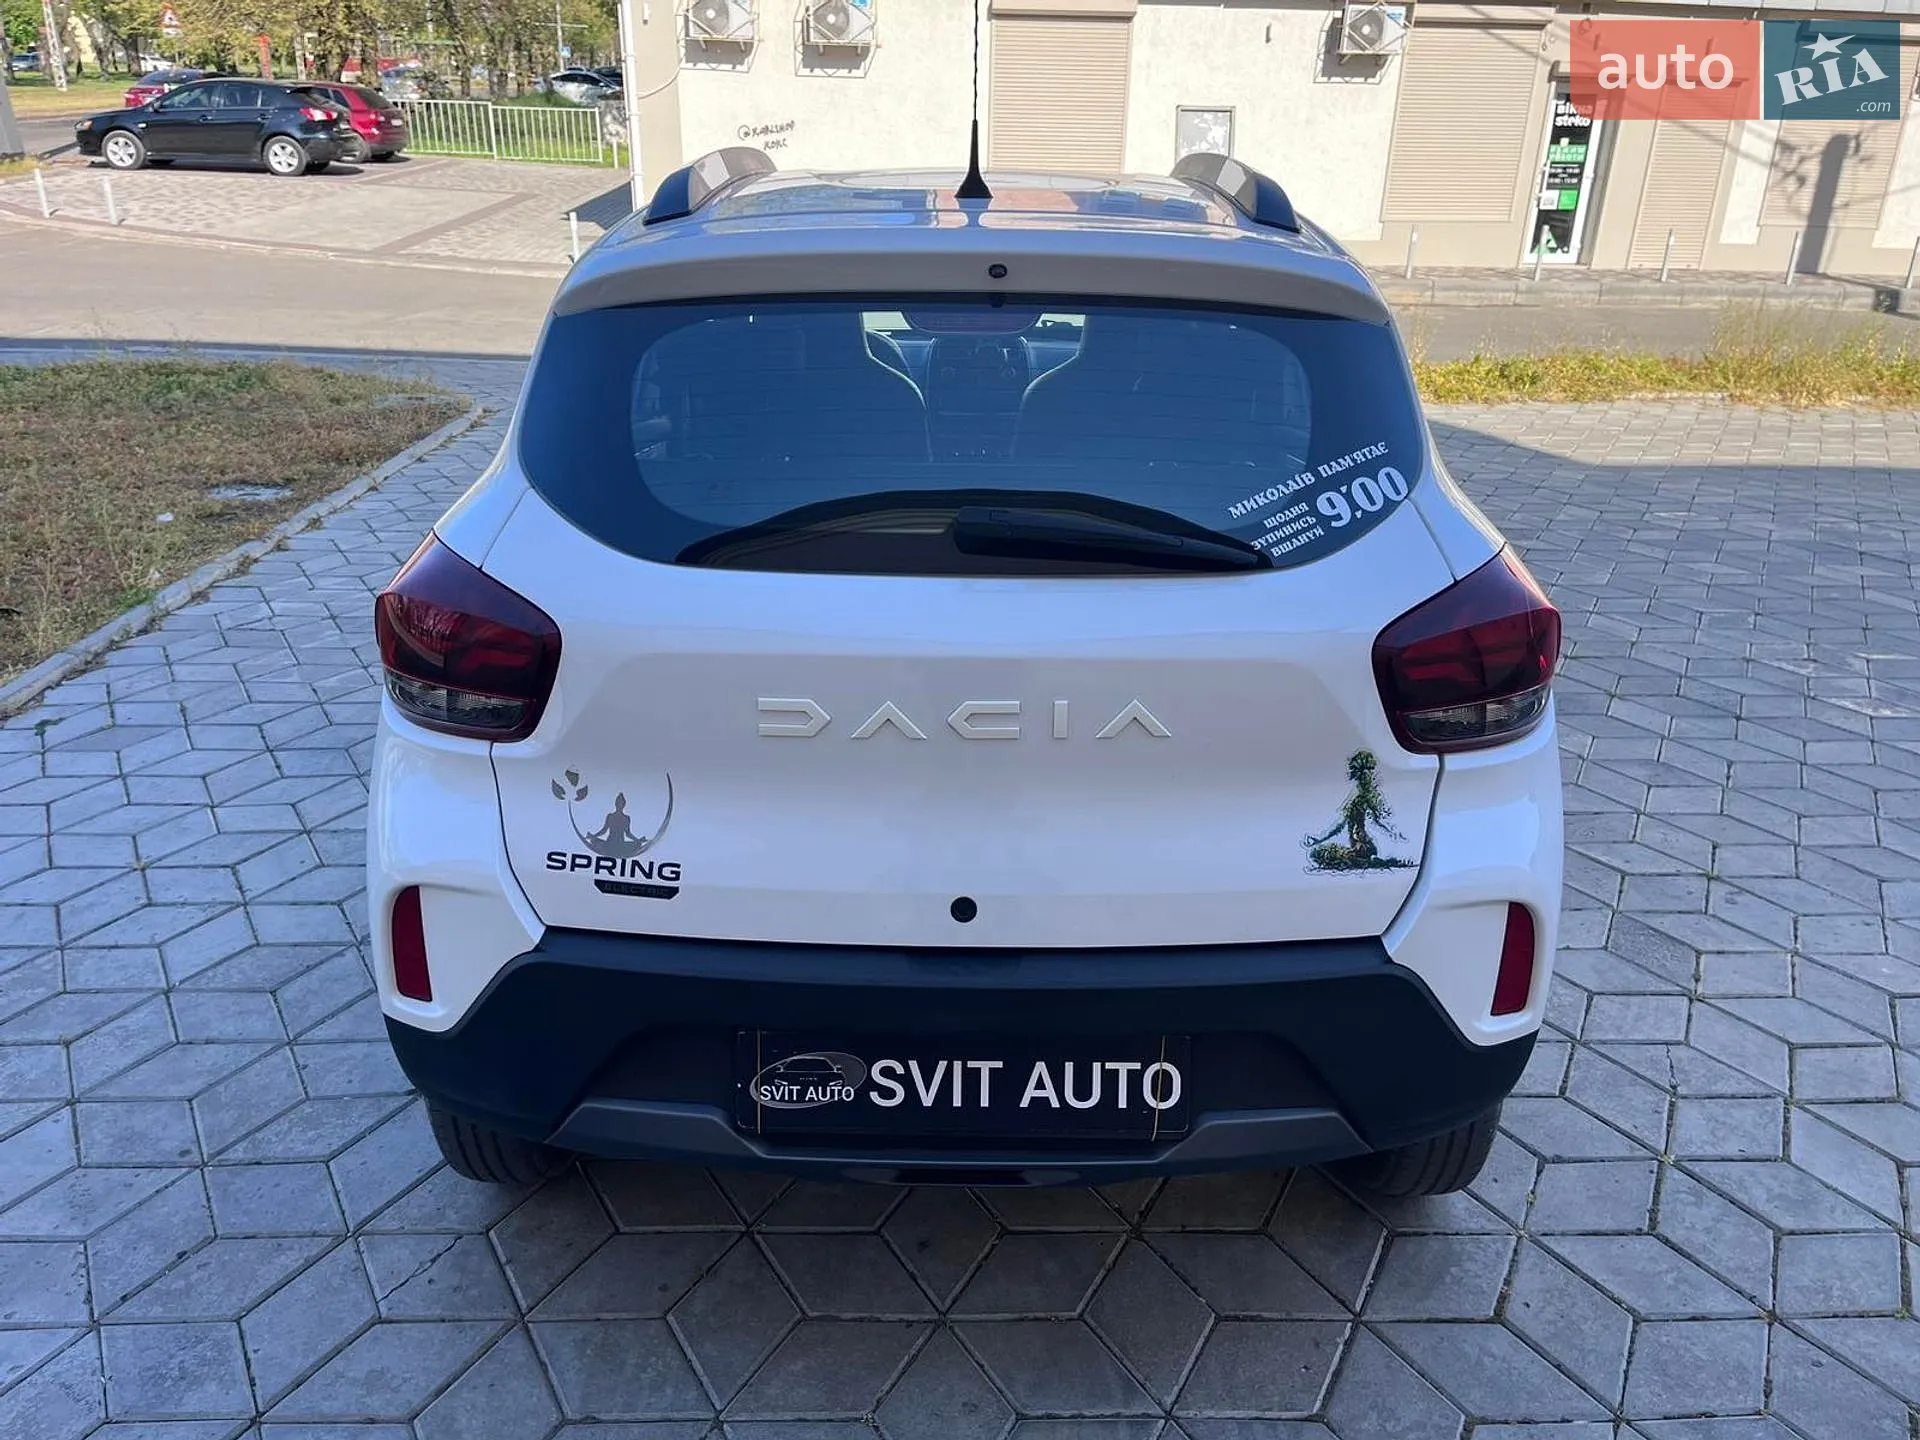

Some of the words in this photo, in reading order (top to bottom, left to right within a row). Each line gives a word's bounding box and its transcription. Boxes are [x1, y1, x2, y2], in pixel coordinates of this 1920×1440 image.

[1227, 472, 1316, 519] МИКОЛАЇВ
[1263, 502, 1310, 529] ЩОДНЯ
[758, 697, 1172, 739] DACIA
[546, 851, 681, 882] SPRING
[760, 1085, 800, 1101] SVIT
[805, 1085, 855, 1101] AUTO
[869, 1059, 1004, 1108] SVIT
[1019, 1060, 1182, 1109] AUTO
